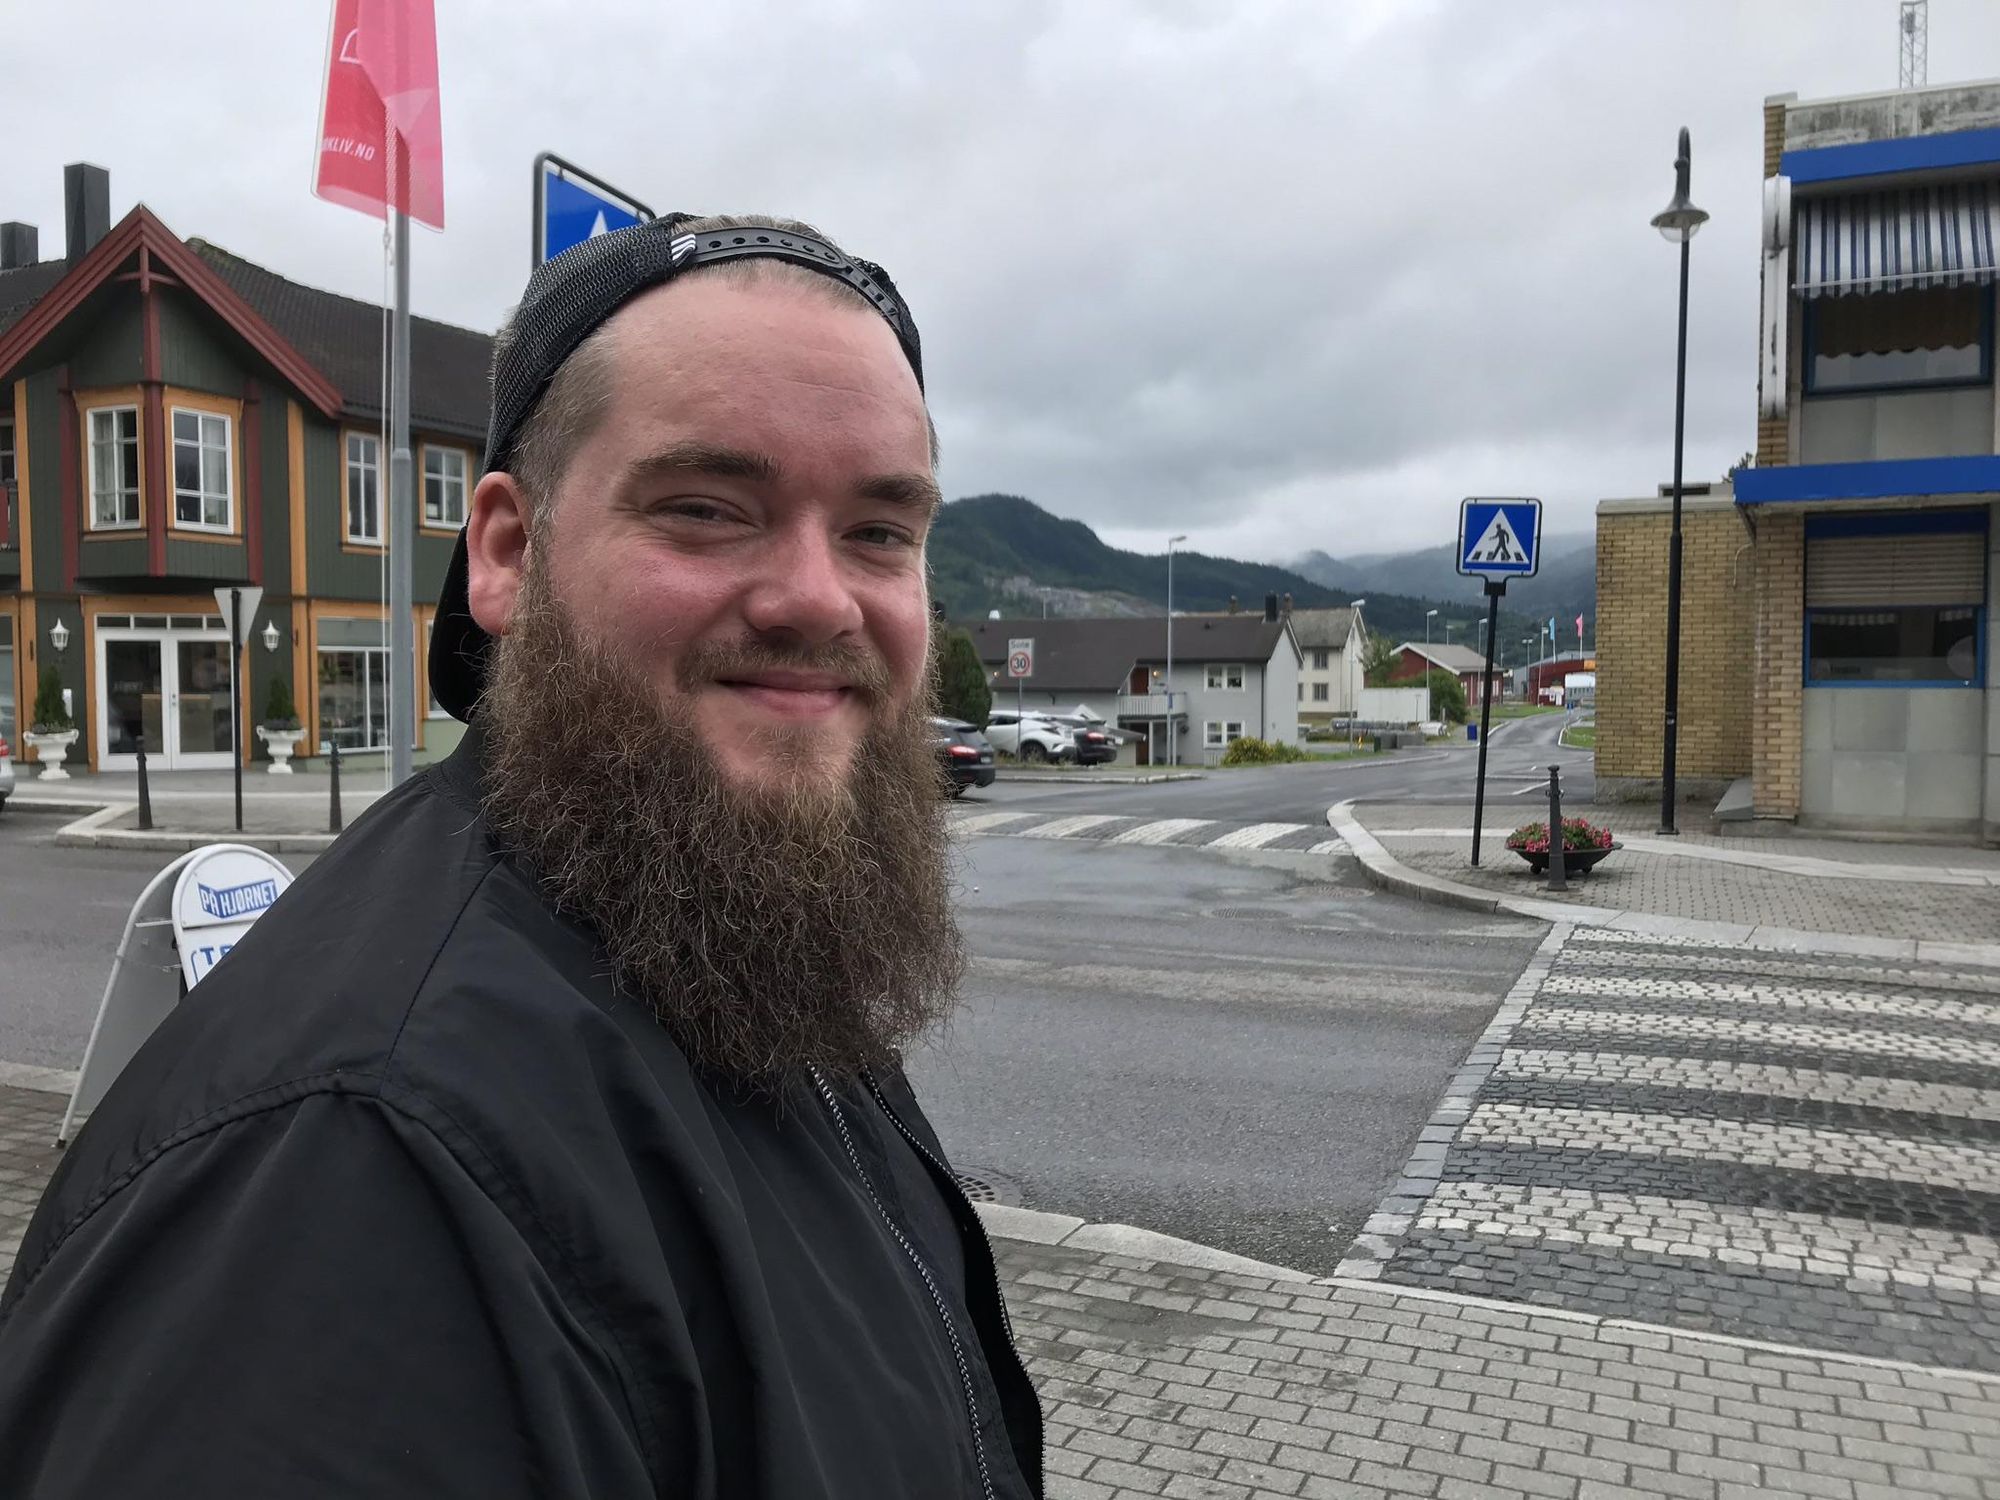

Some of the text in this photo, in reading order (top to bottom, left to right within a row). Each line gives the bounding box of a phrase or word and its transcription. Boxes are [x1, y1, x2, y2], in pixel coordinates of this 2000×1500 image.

[1014, 657, 1027, 669] 30
[201, 881, 275, 916] PÅ HJØRNET
